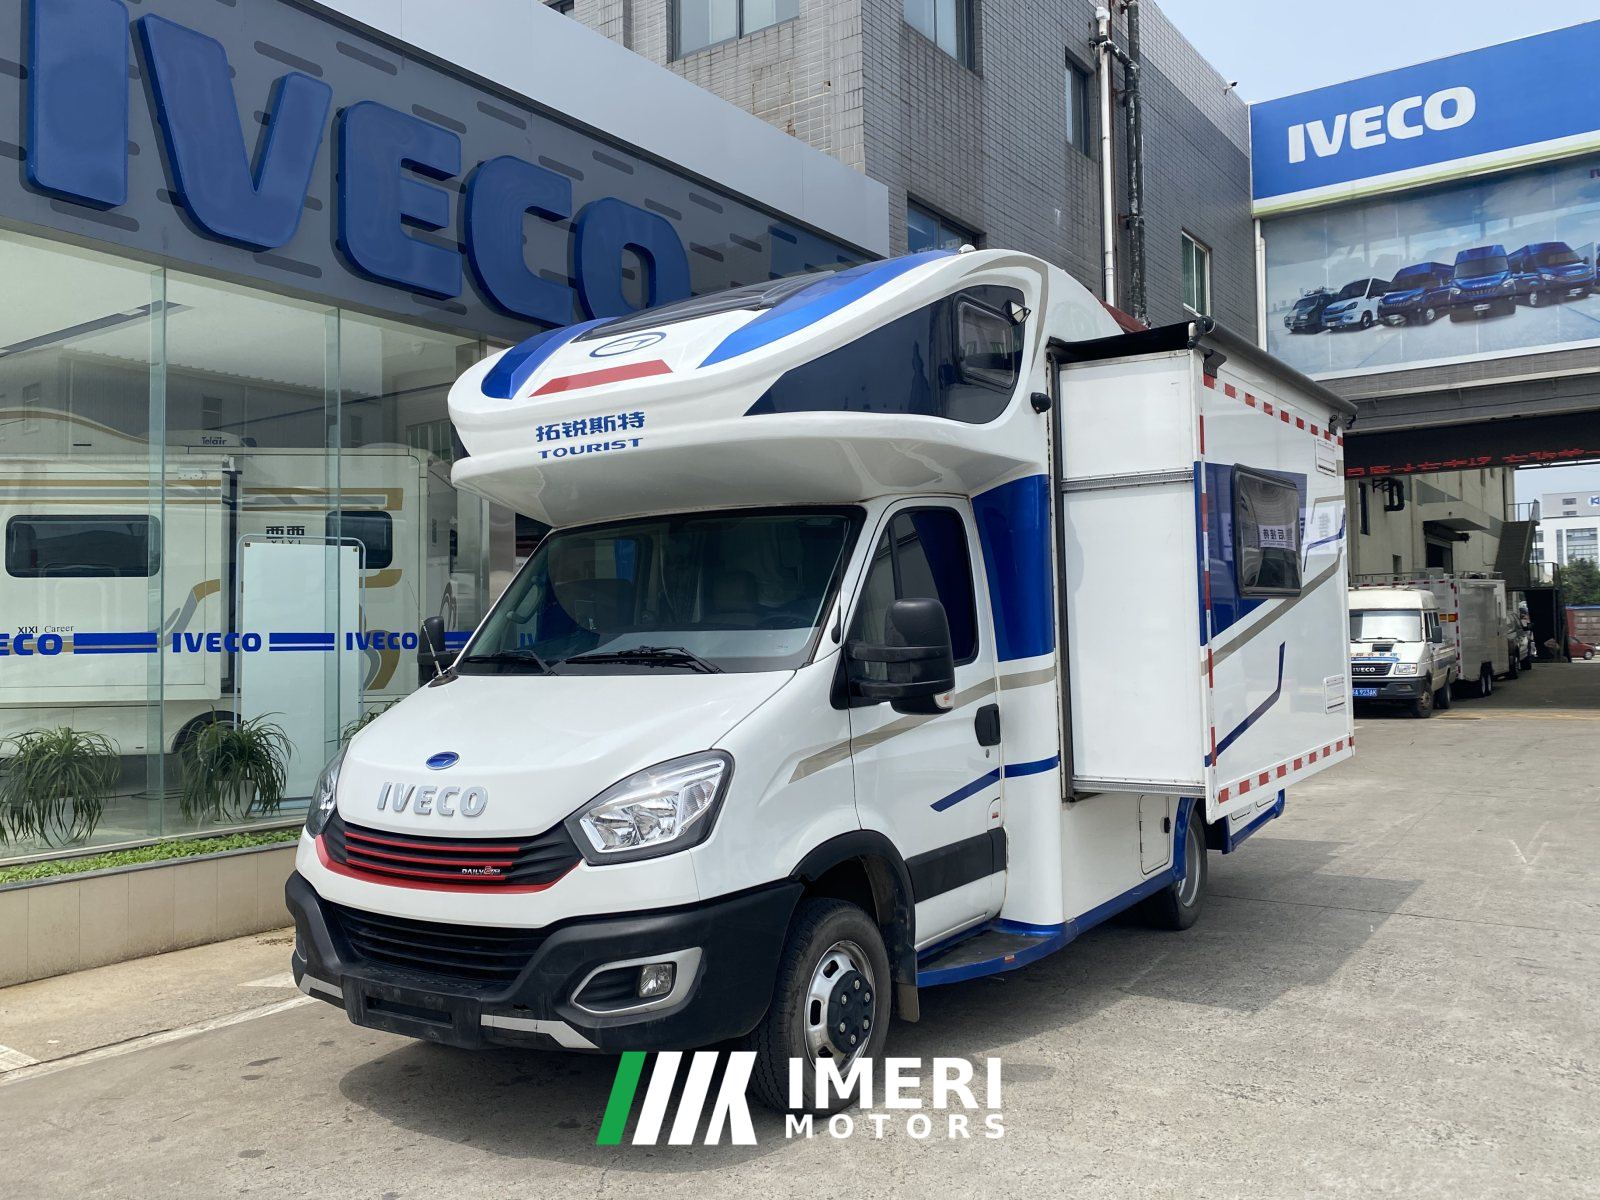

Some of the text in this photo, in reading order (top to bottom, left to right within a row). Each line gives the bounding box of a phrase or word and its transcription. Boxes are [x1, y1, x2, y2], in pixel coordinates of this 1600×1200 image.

[1287, 86, 1477, 164] IVECO
[27, 0, 692, 327] IVECO
[535, 411, 646, 442] 拓锐斯特
[201, 436, 228, 446] Telair
[537, 437, 644, 459] TOURIST
[18, 625, 75, 634] XIXI Career
[172, 632, 262, 653] IVECO
[345, 632, 418, 650] IVECO
[376, 781, 489, 818] IVECO
